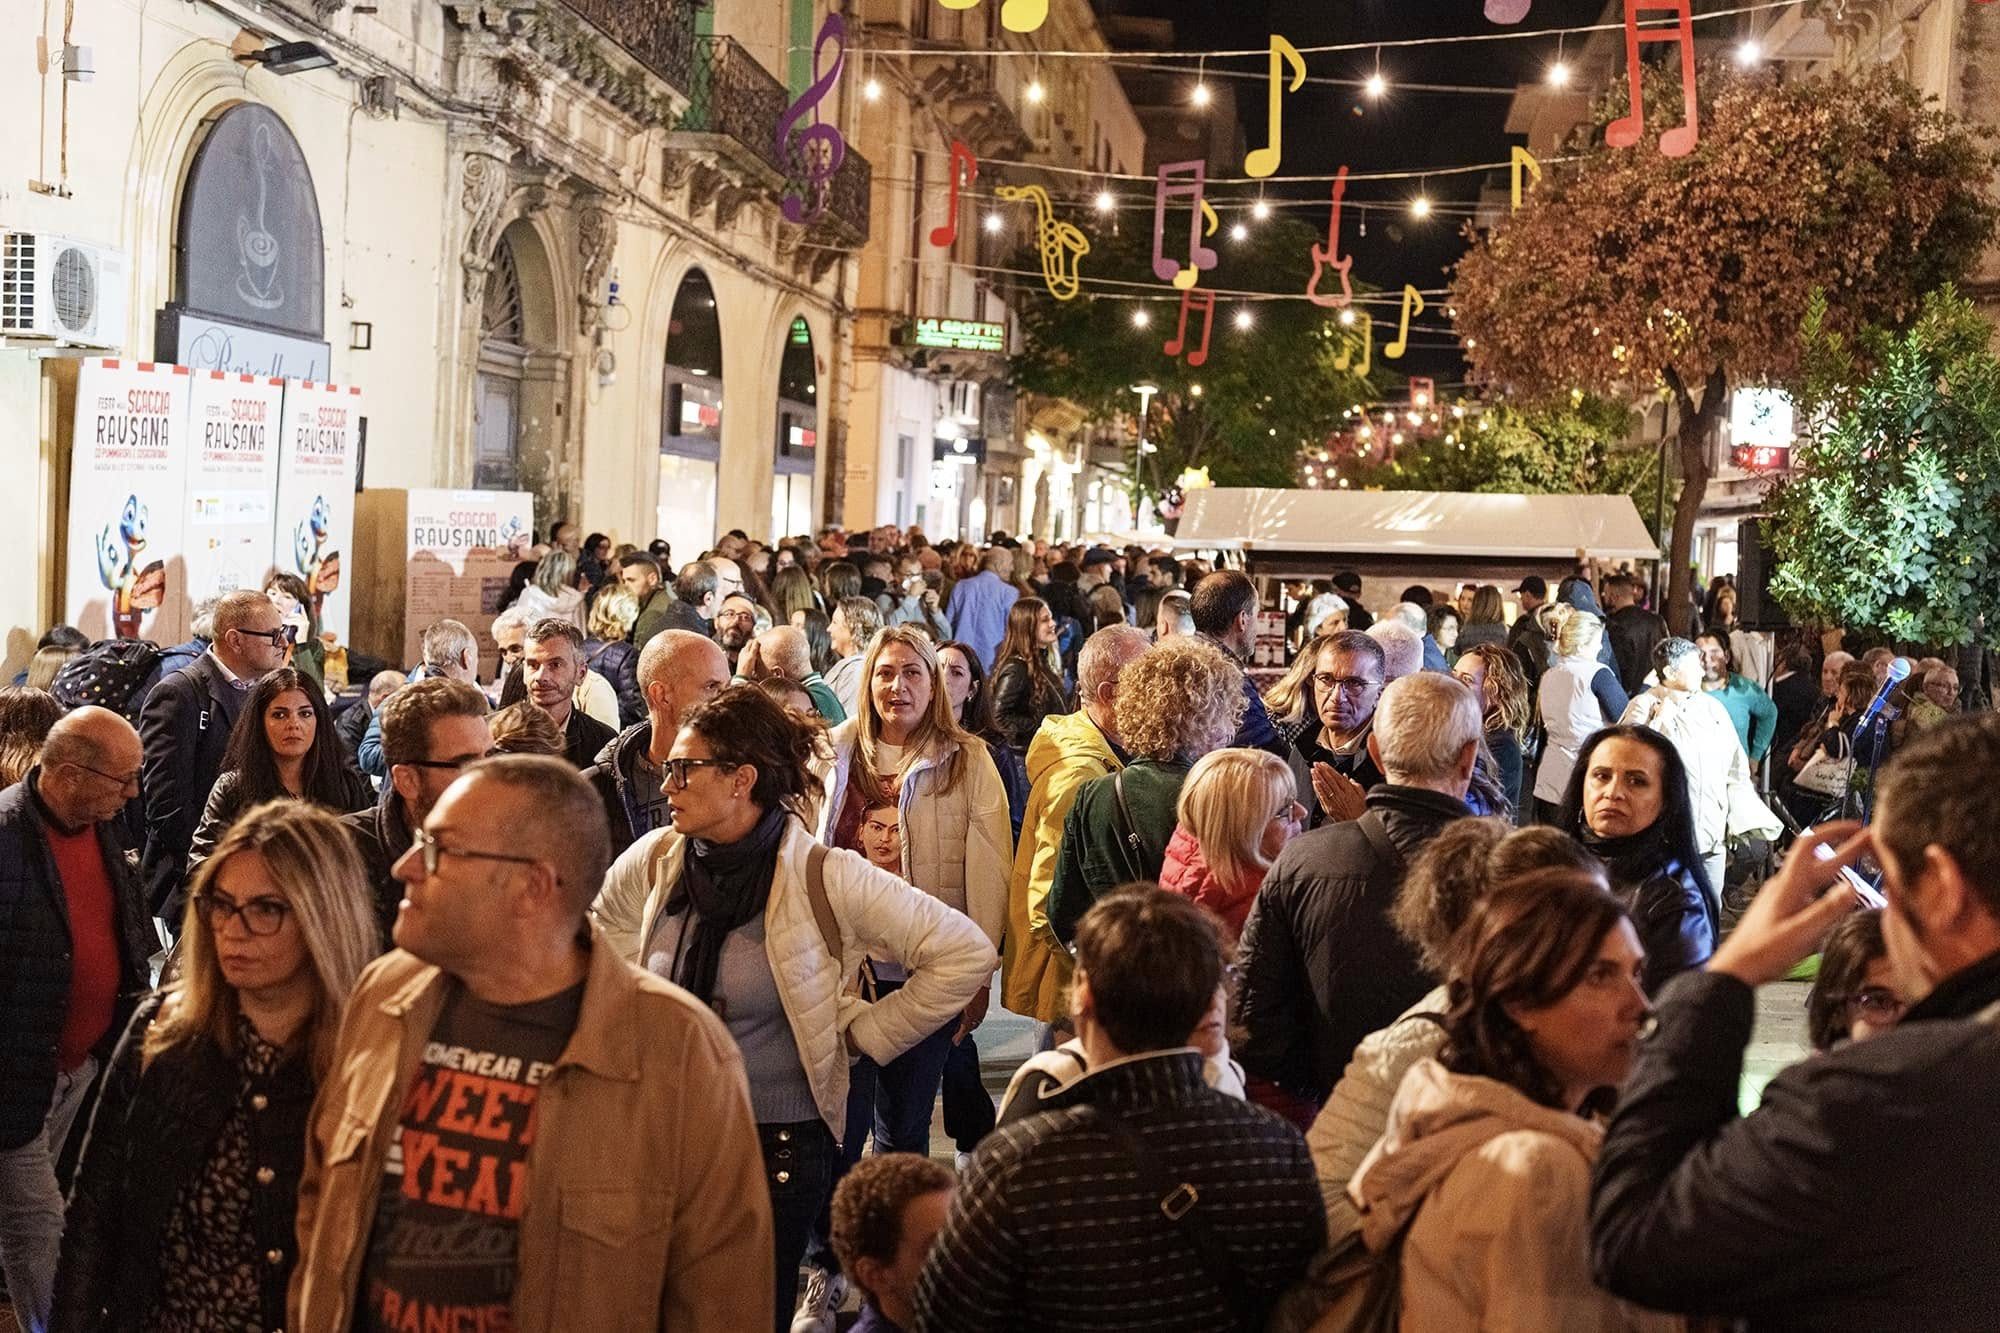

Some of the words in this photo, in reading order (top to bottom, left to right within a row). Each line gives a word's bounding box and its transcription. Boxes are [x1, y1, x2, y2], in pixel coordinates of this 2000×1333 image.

[128, 389, 170, 415] SCACCIA
[232, 398, 266, 421] SCACCIA
[96, 415, 169, 446] RAUSANA
[205, 421, 265, 450] RAUSANA
[296, 427, 345, 454] RAUSANA
[449, 511, 497, 528] SCACCIA
[415, 528, 497, 547] RAUSANA
[423, 1042, 523, 1081] OMEWEAR
[401, 1067, 540, 1146] WEET
